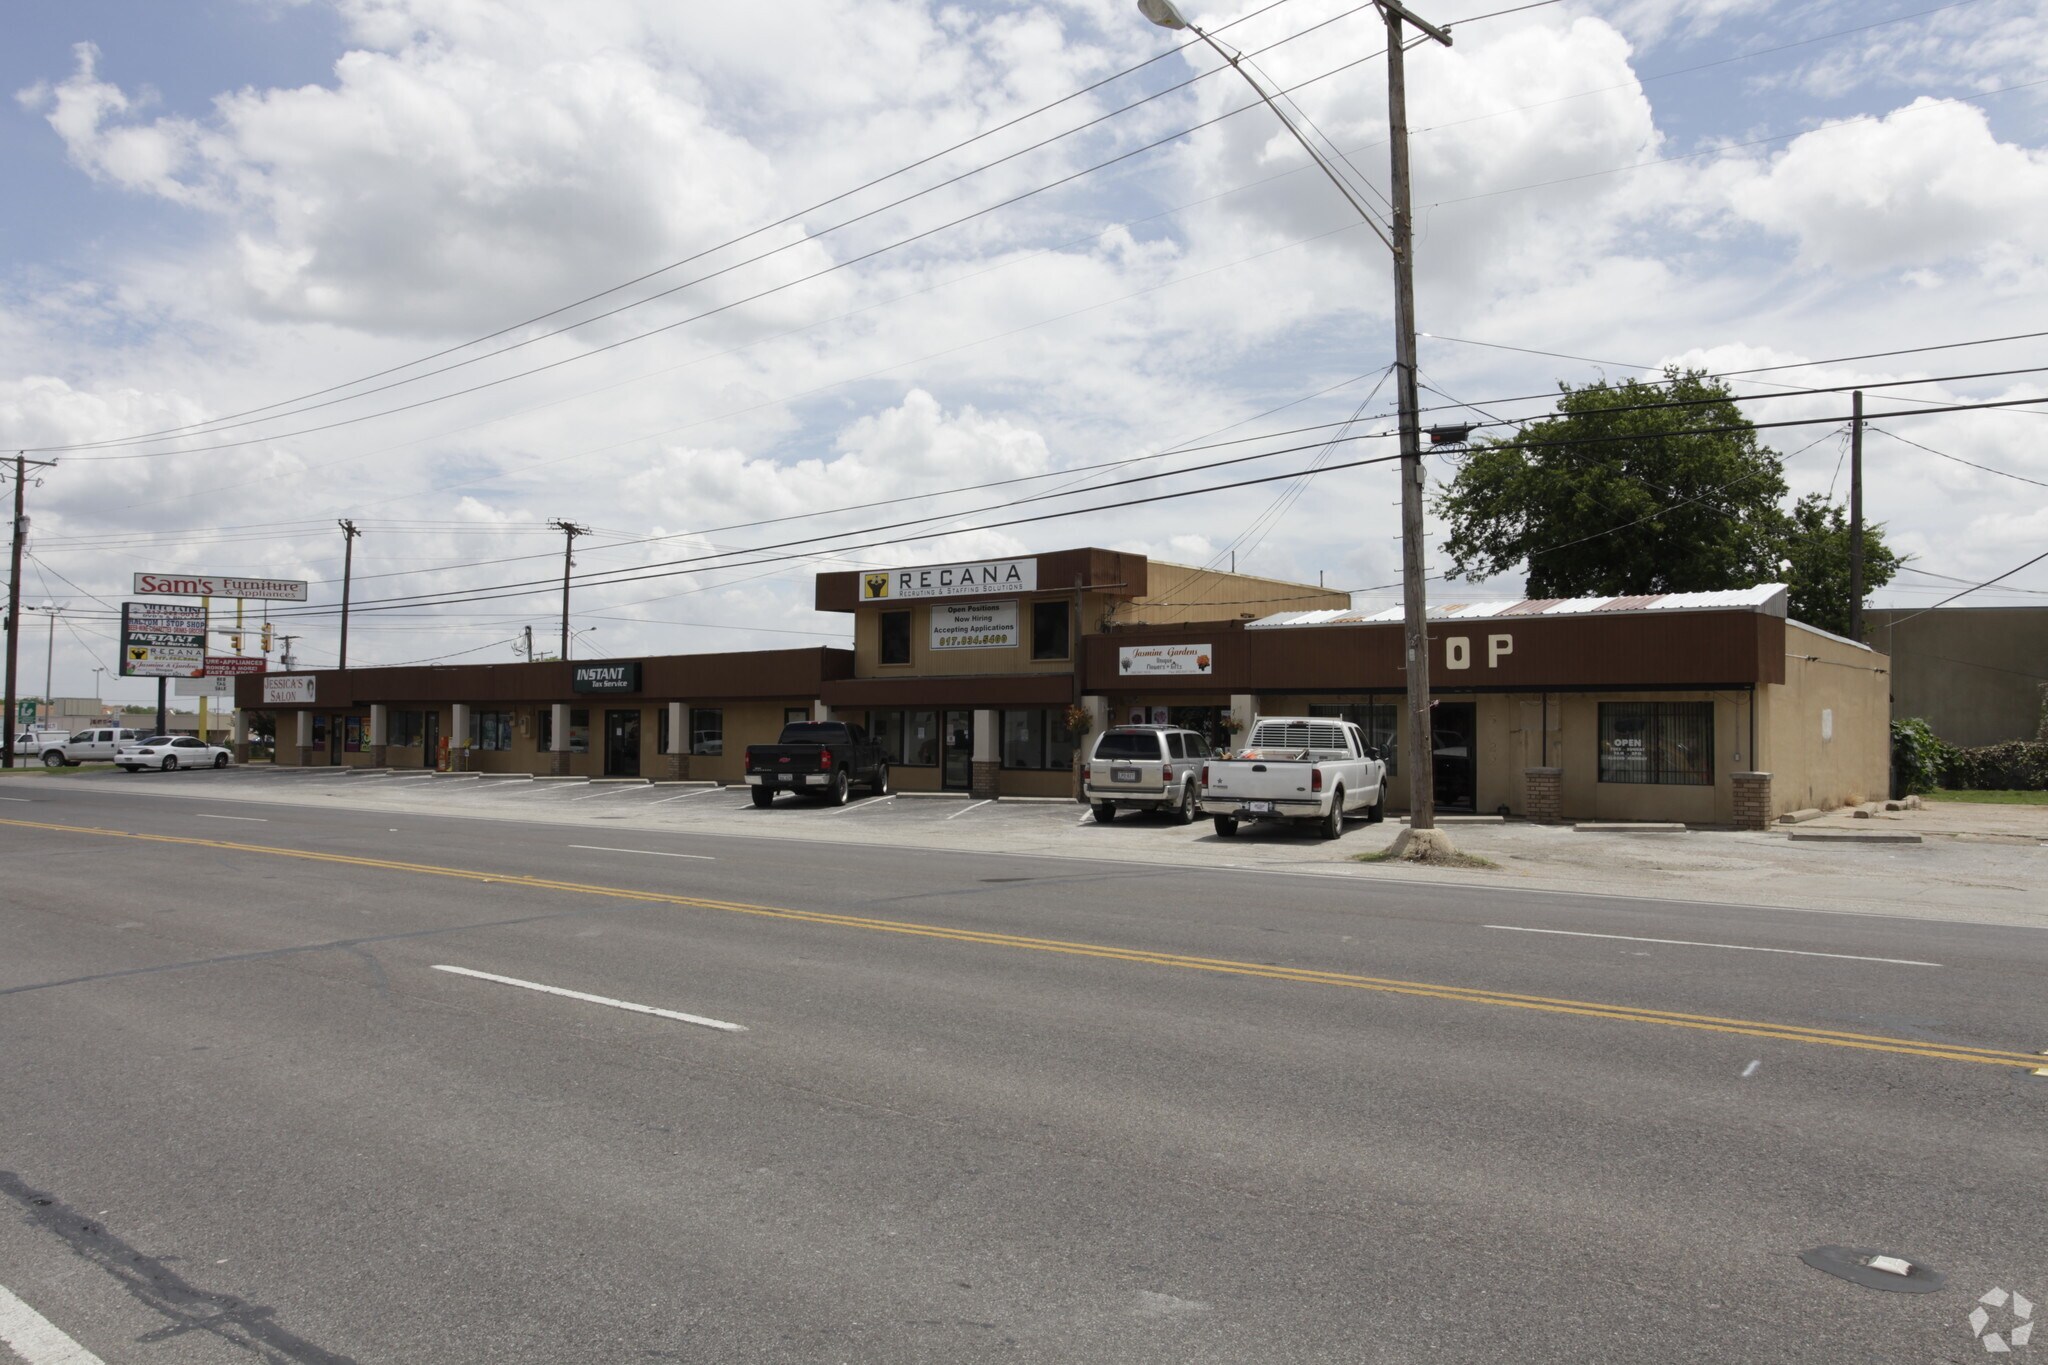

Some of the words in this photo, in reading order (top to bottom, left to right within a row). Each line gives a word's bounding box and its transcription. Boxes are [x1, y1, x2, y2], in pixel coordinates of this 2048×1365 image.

[900, 565, 1021, 589] RECANA
[140, 575, 214, 595] Sam's
[223, 579, 299, 591] Furniture
[947, 585, 979, 594] STAFFING
[983, 584, 1023, 592] SOLUTIONS
[237, 589, 296, 598] Appliances
[934, 626, 969, 634] Accepting
[970, 624, 1014, 632] Applications
[129, 633, 196, 642] INSTANT
[151, 648, 202, 656] RECANA
[1132, 648, 1162, 658] Jasmine
[1167, 647, 1198, 657] Gardens
[577, 667, 624, 680] INSTANT
[264, 679, 304, 689] JESSICA'S
[270, 690, 297, 701] SALON
[1614, 739, 1642, 747] OPEN
